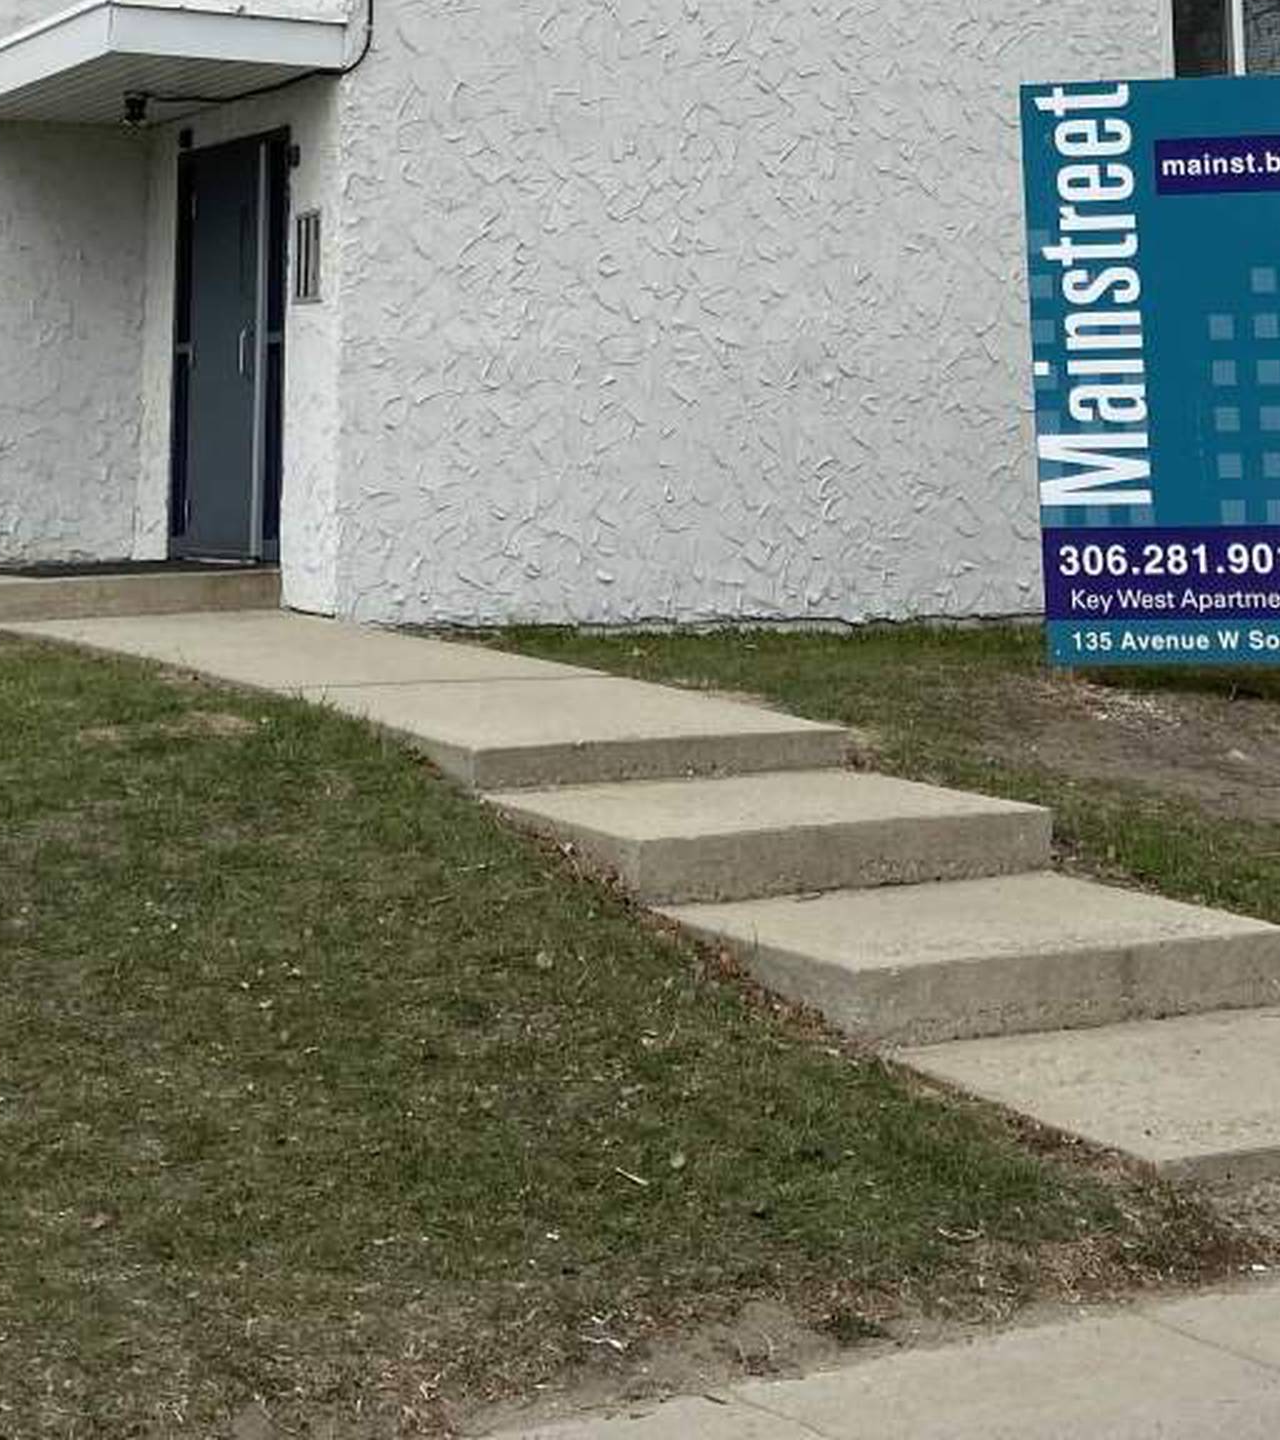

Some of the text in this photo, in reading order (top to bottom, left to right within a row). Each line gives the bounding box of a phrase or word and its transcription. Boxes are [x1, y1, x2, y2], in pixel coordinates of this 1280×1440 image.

[1034, 82, 1153, 508] Mainstreet
[1071, 589, 1113, 613] Key
[1116, 589, 1175, 610] West
[1072, 632, 1112, 651] 135
[1121, 632, 1209, 650] Avenue
[1217, 631, 1239, 649] W
